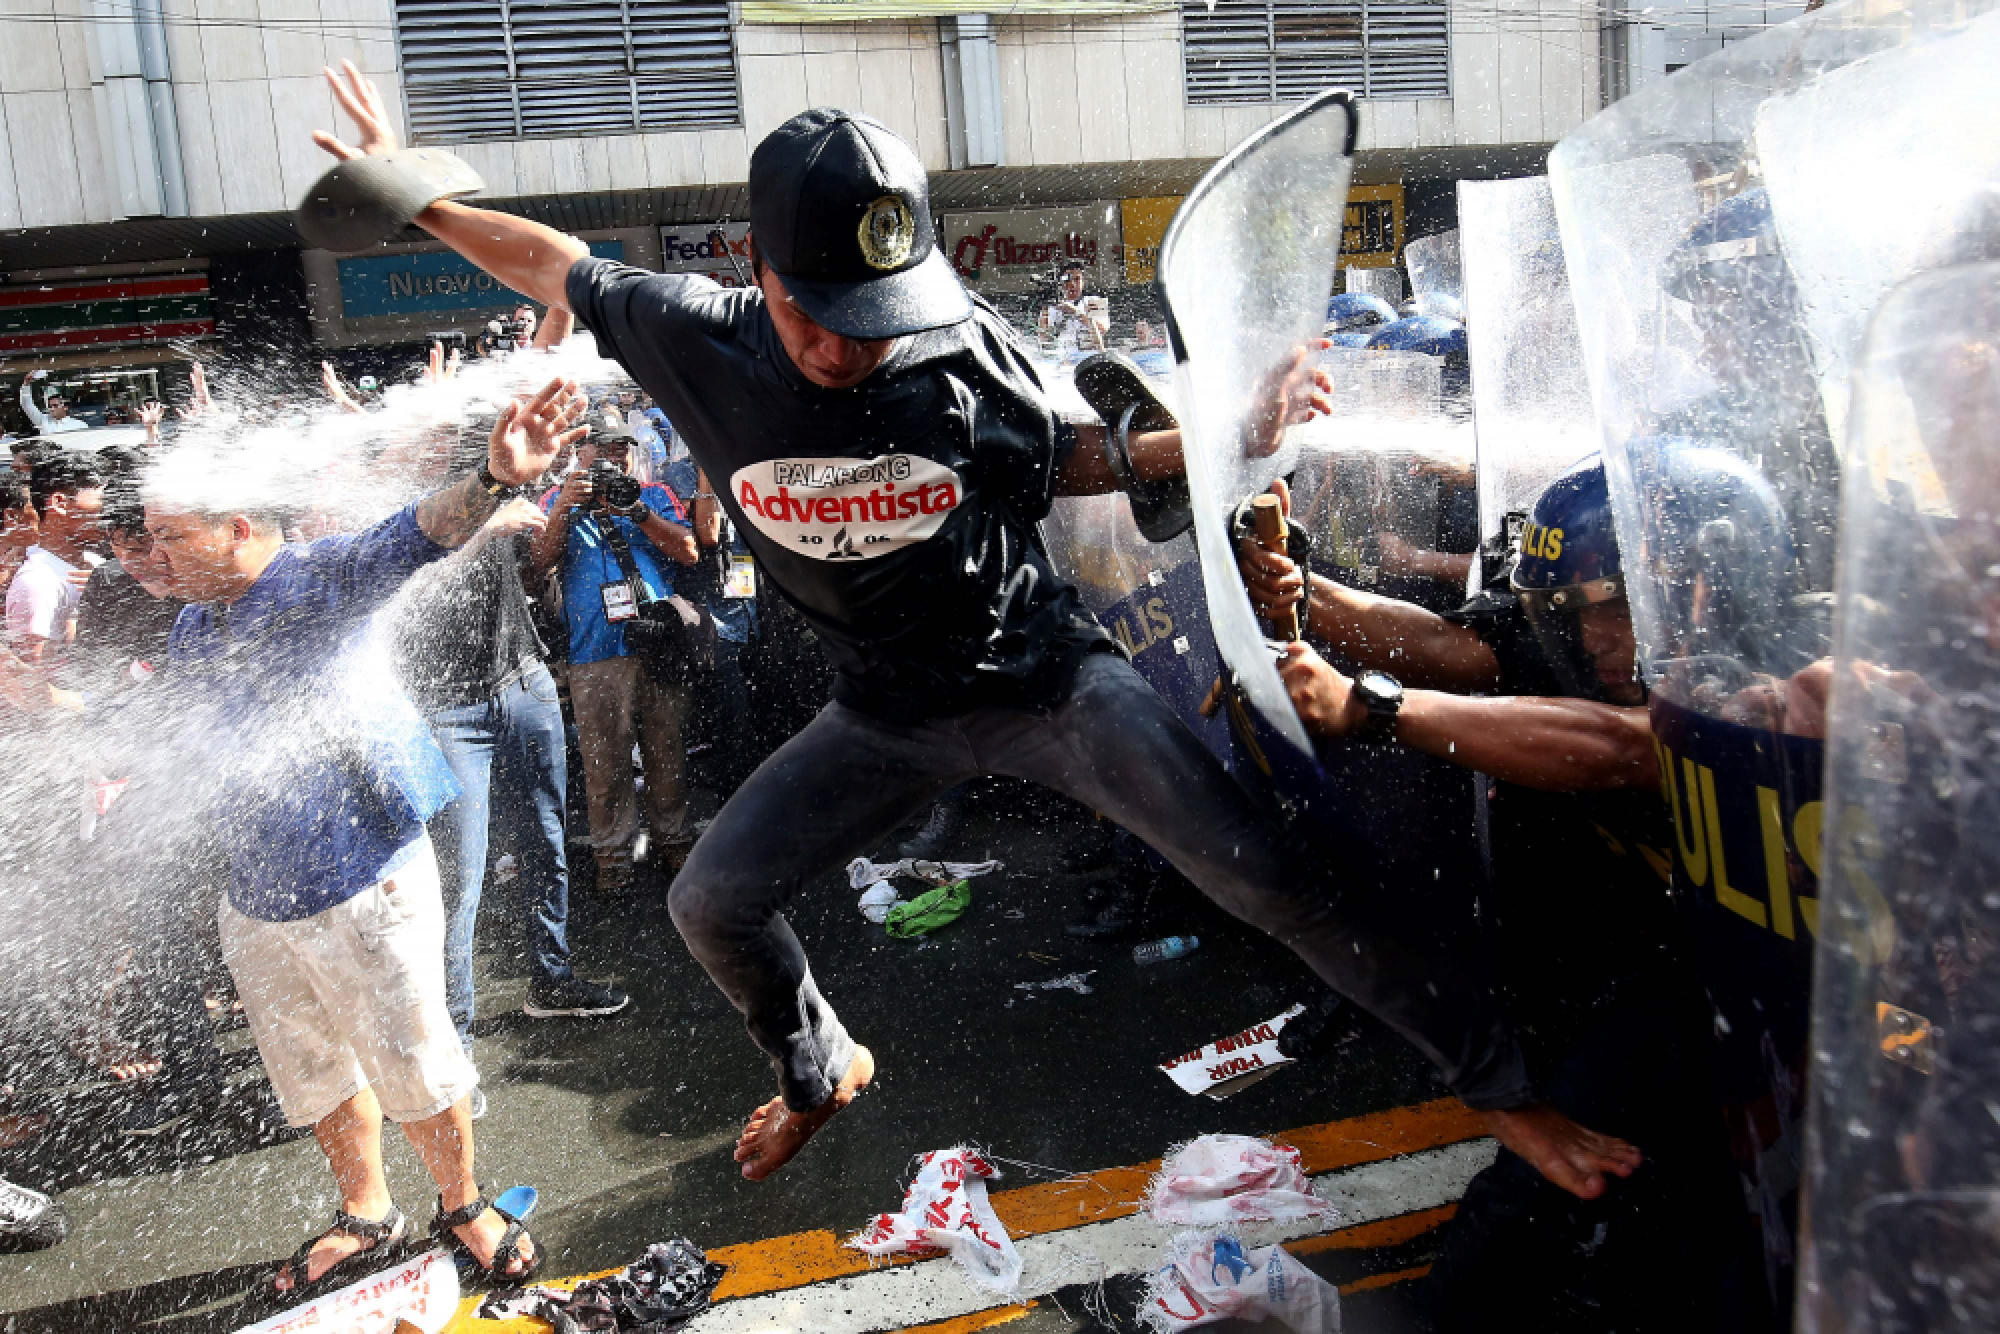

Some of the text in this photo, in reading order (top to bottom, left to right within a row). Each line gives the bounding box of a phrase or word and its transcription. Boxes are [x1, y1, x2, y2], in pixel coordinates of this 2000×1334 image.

[664, 232, 749, 261] FedEx
[740, 480, 957, 524] Adventista
[1206, 1053, 1265, 1080] POOR
